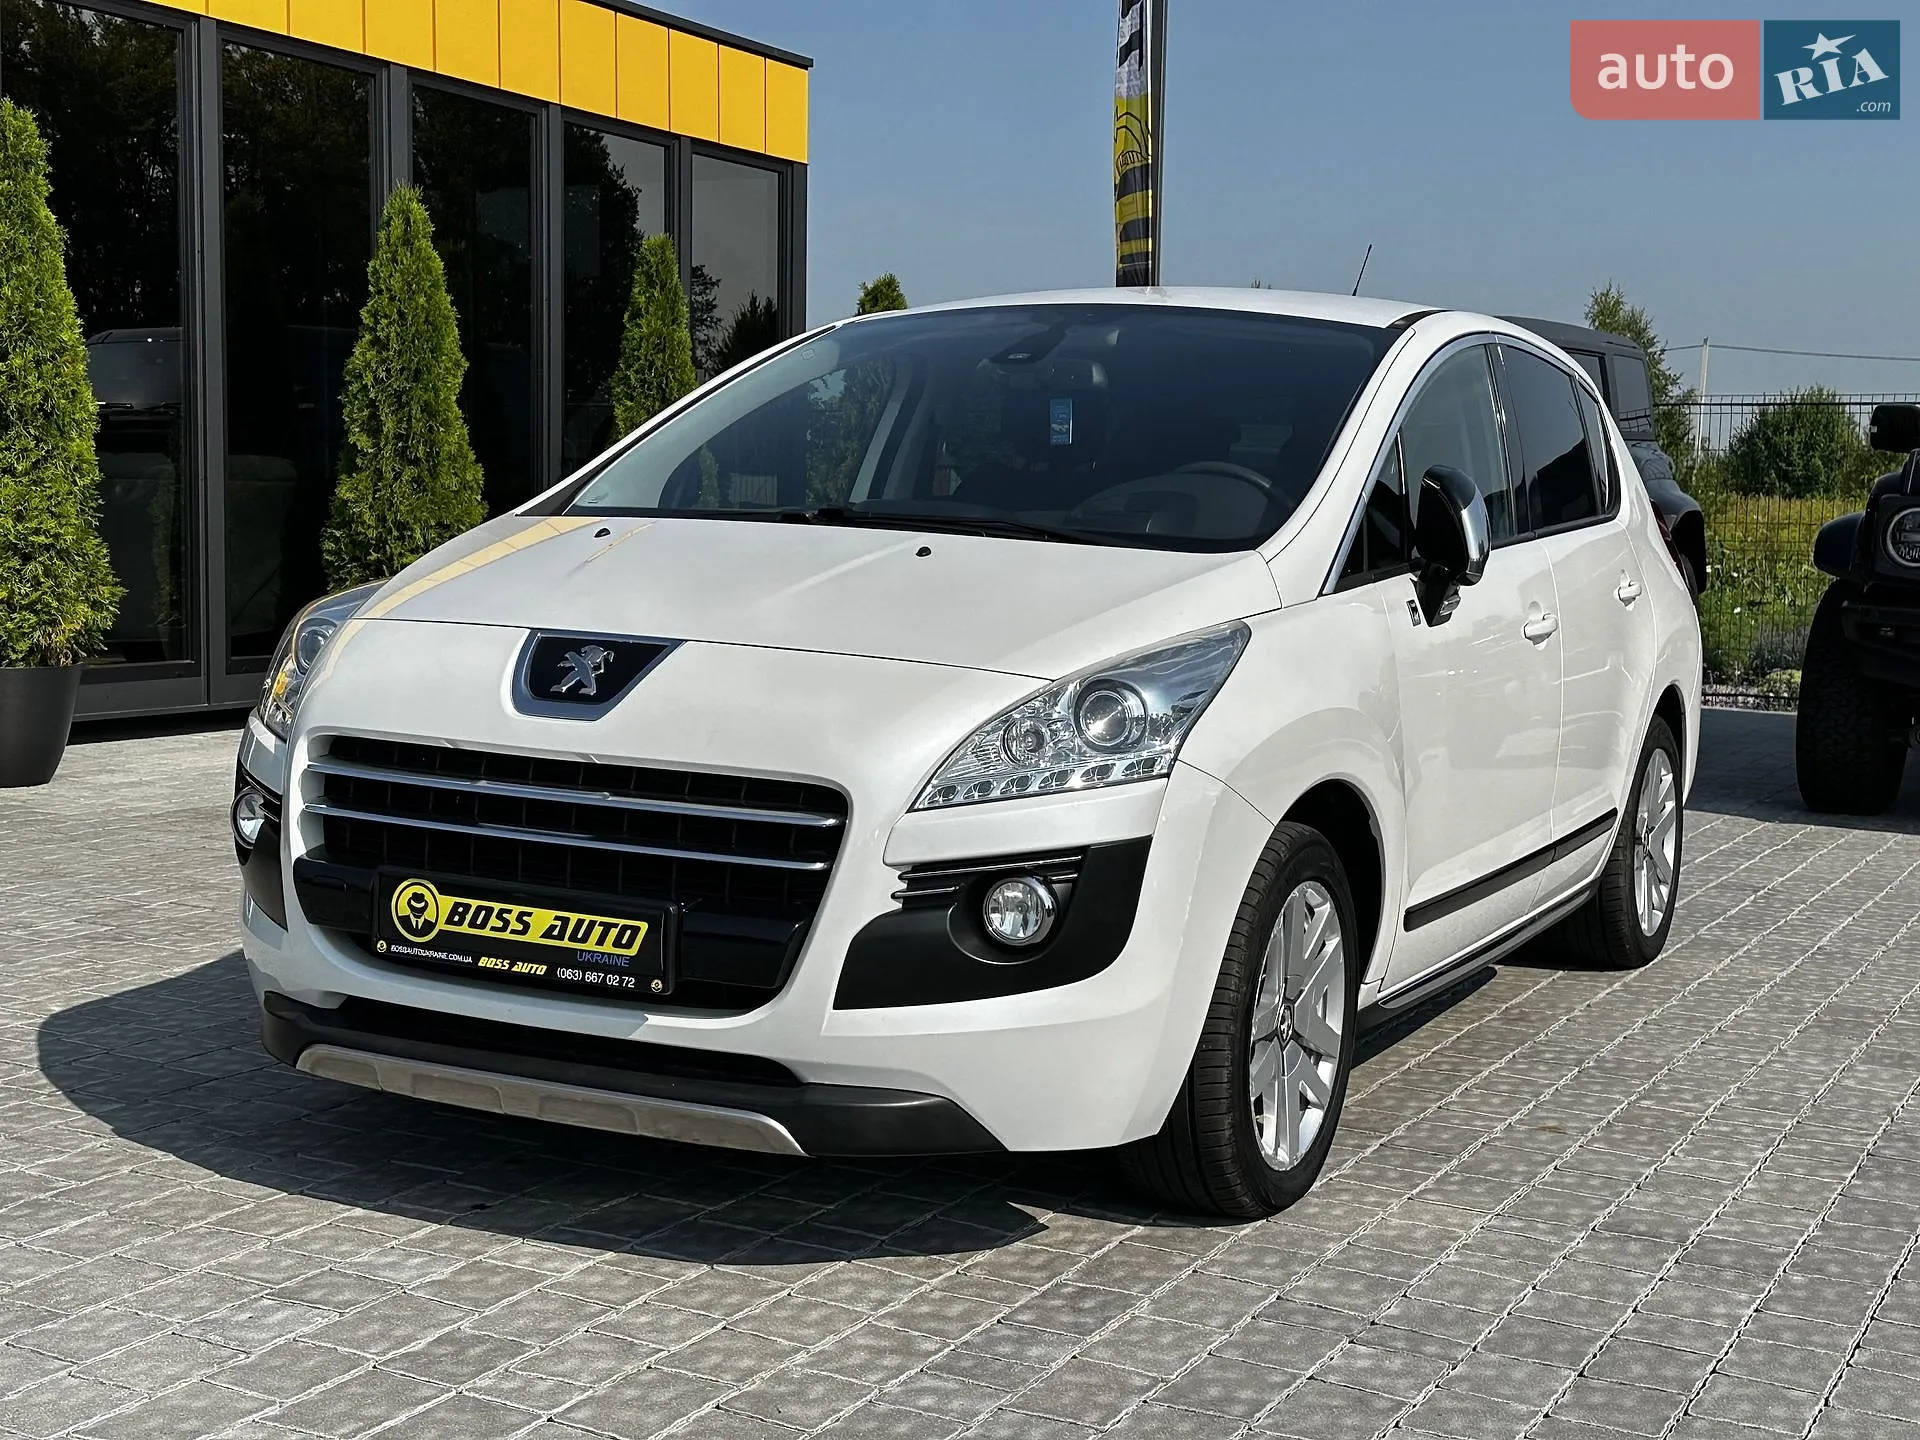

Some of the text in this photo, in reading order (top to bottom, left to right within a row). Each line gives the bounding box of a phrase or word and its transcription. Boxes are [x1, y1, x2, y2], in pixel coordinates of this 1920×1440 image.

[443, 900, 640, 950] BOSS AUTO
[477, 956, 548, 975] BOSS AUTO
[577, 950, 631, 967] UKRAINE
[556, 967, 635, 988] (063) 667 02 72
